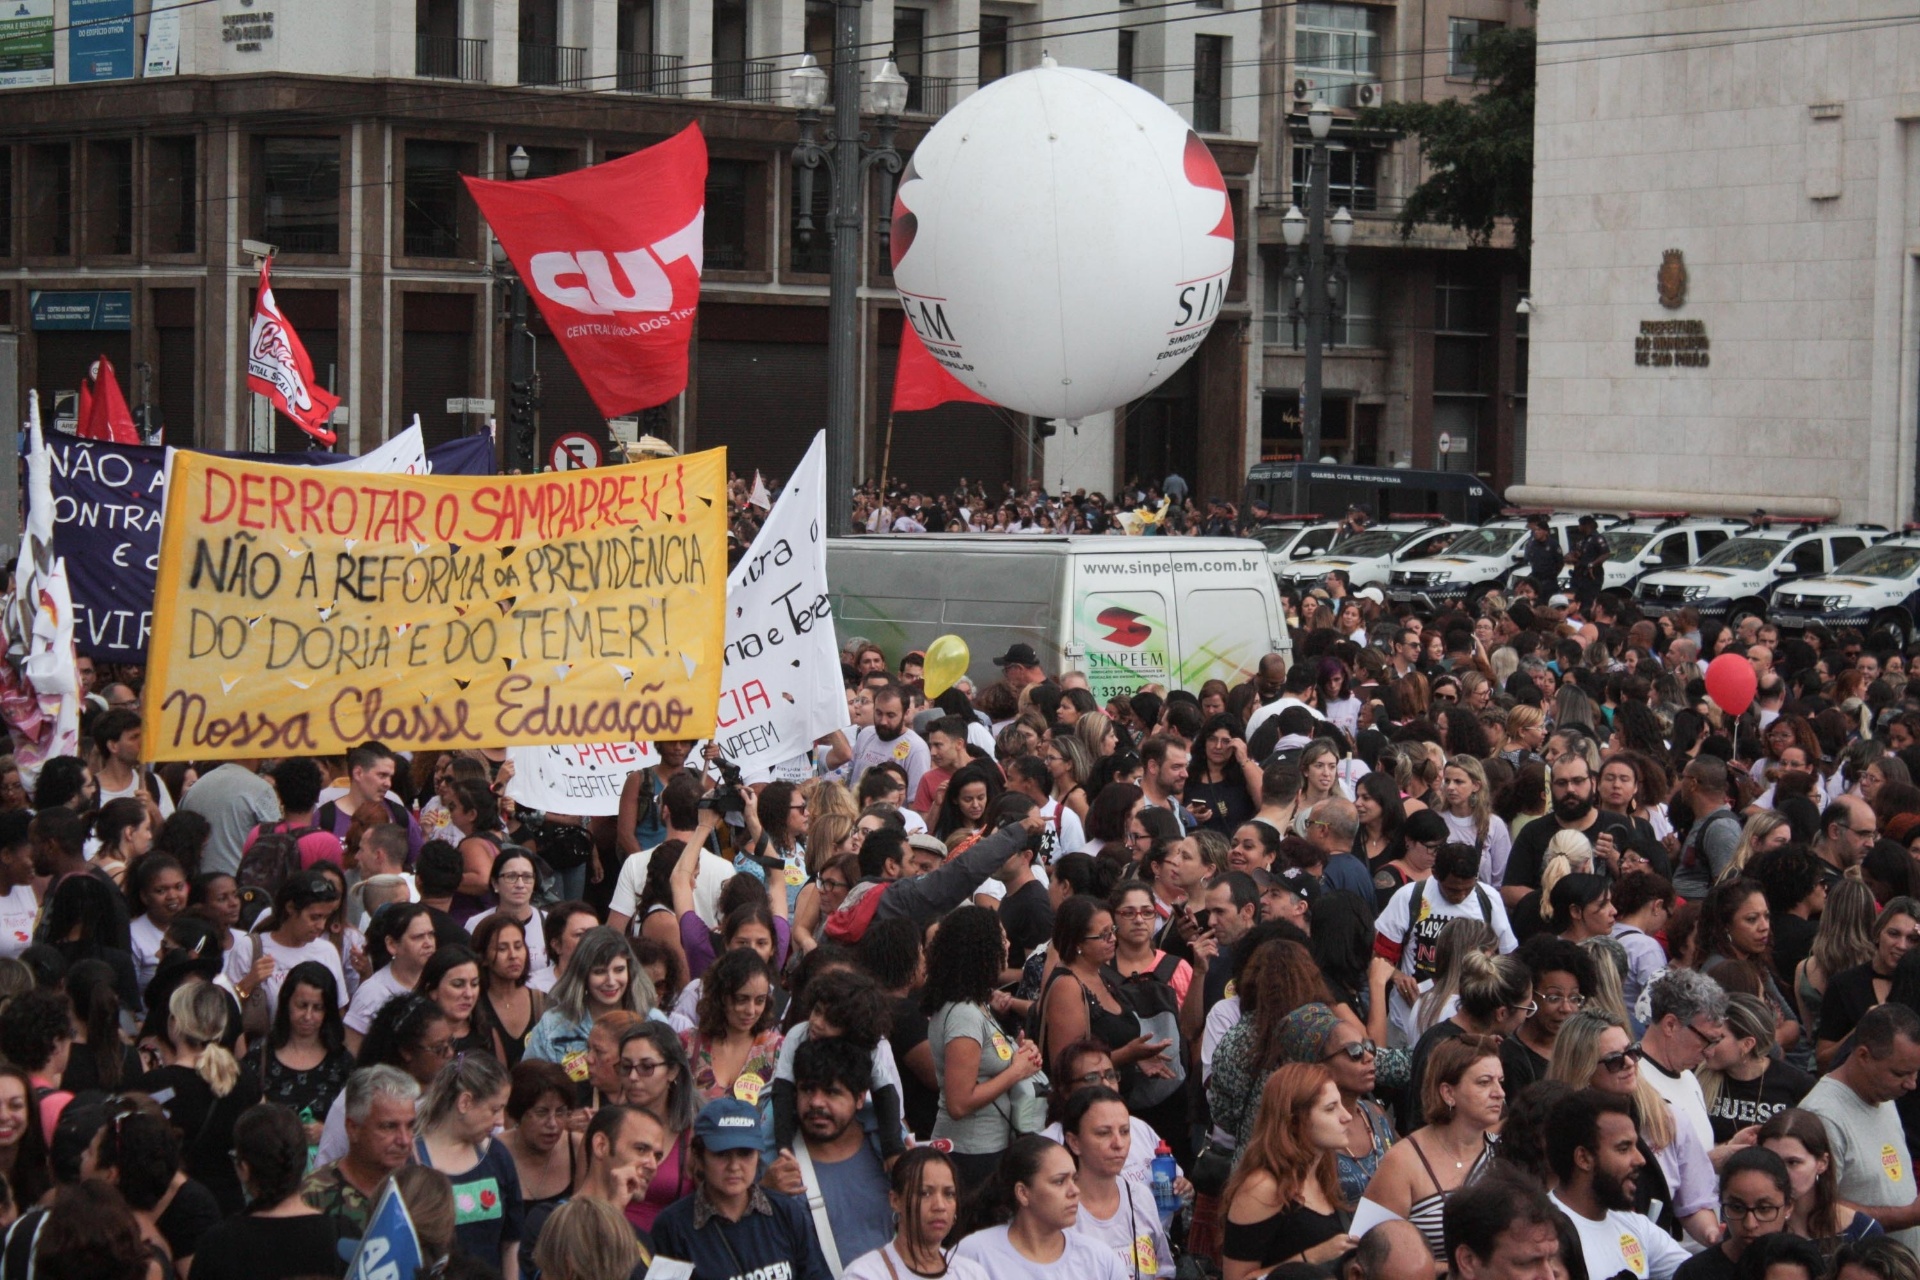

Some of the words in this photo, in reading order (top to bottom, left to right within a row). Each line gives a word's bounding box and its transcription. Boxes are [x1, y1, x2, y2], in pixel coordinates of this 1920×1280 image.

[530, 210, 704, 316] CUT
[639, 316, 671, 333] DOS
[902, 296, 956, 341] EM
[47, 442, 133, 488] NÃO
[1336, 473, 1353, 481] CIVIL
[1353, 474, 1402, 484] METROPOLITANA
[201, 467, 427, 544] DERROTAR
[434, 492, 460, 543] O
[1469, 486, 1483, 497] K9
[112, 542, 130, 568] E
[189, 530, 281, 600] NÃO
[333, 552, 489, 604] REFORMA
[494, 564, 520, 588] DA
[525, 524, 706, 594] PREVIDÊNCIA
[742, 538, 794, 588] tra
[1083, 558, 1259, 577] www.sinpeem.com.br
[188, 607, 248, 660] DO
[407, 623, 431, 667] E
[443, 617, 498, 665] DO
[511, 597, 671, 662] TEMER!
[1090, 652, 1164, 668] SINPEEM
[160, 689, 318, 749] Nossa
[328, 686, 483, 743] Classe
[494, 673, 693, 742] Educação
[561, 773, 622, 798] DEBATE
